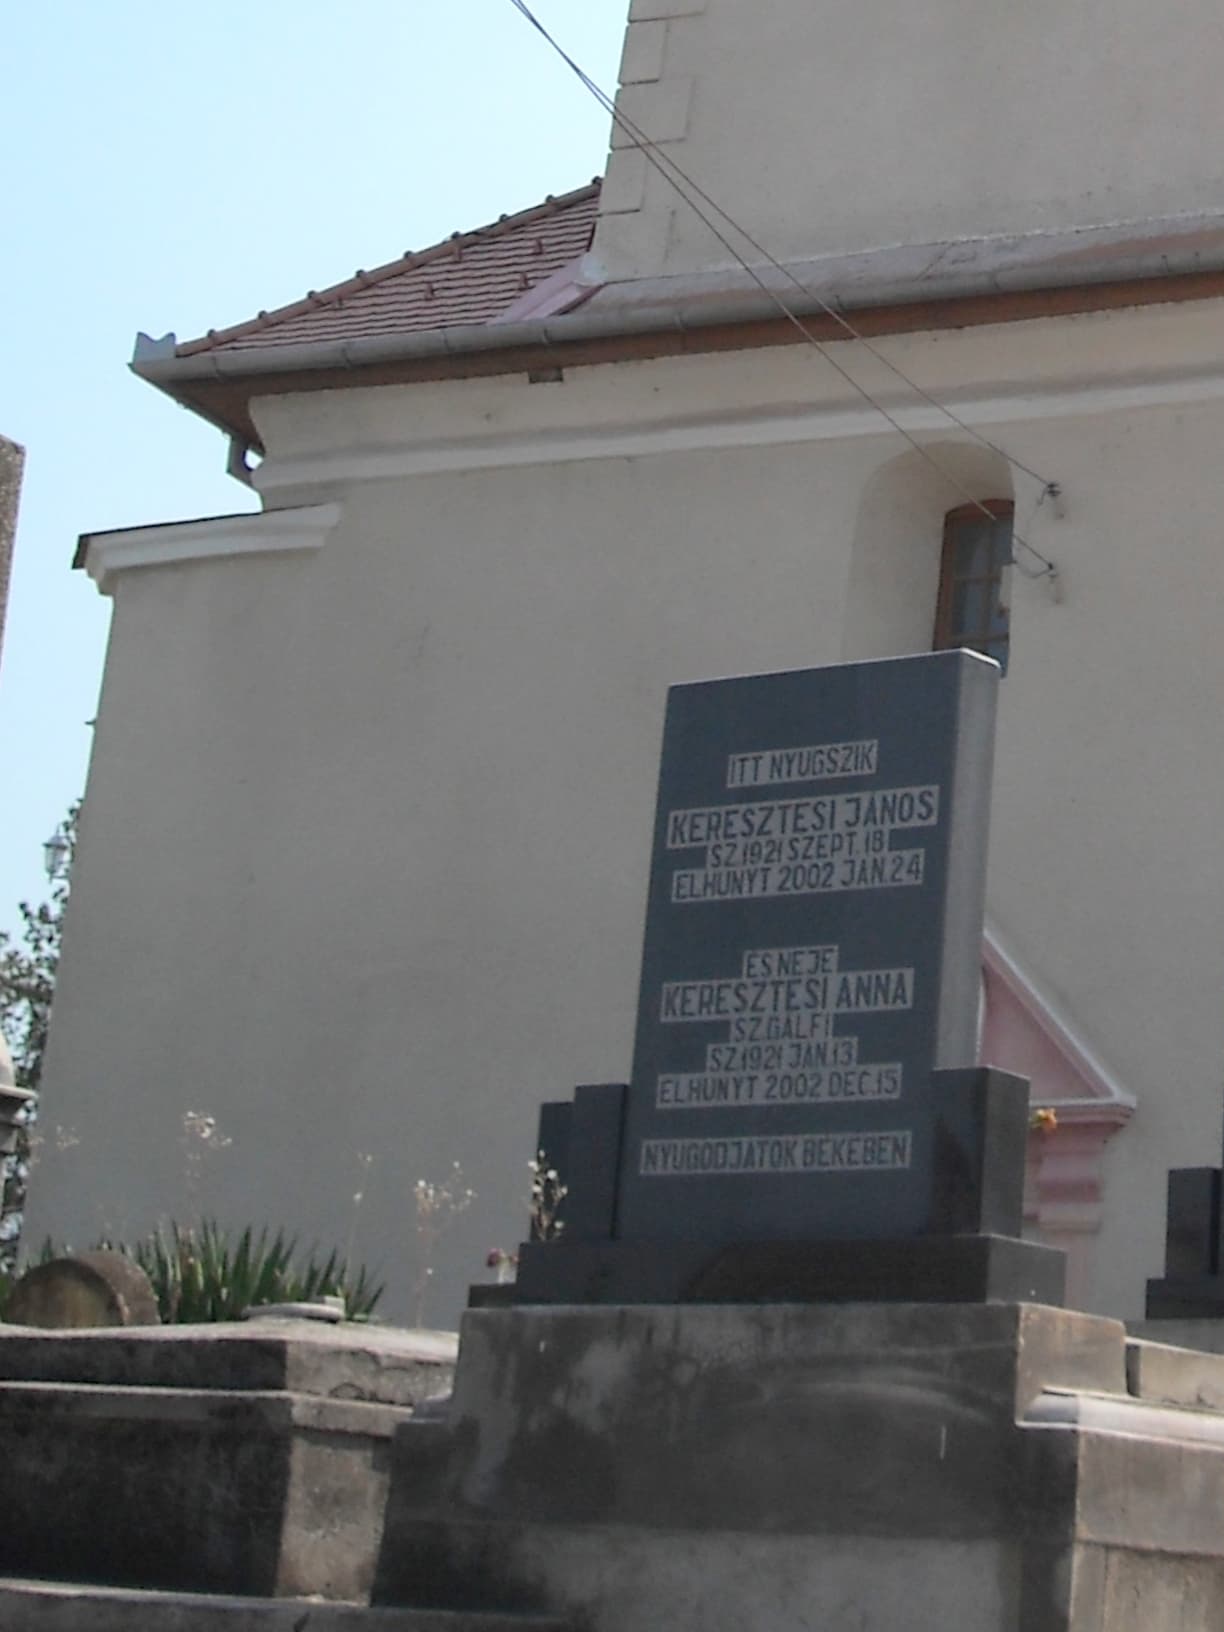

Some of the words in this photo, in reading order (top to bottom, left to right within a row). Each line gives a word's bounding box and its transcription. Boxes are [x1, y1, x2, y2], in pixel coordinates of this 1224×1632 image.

[730, 755, 763, 785] ITT
[768, 744, 873, 780] NYUGSZIK
[671, 800, 836, 845] KERESZTESI
[864, 829, 885, 854] 18
[675, 867, 771, 899] ELHUNYT
[777, 862, 834, 892] 2002
[664, 978, 828, 1017] KERESZTESI
[835, 973, 909, 1009] ANNA
[659, 1074, 758, 1105] ELHUNYT
[764, 1071, 823, 1099] 2002
